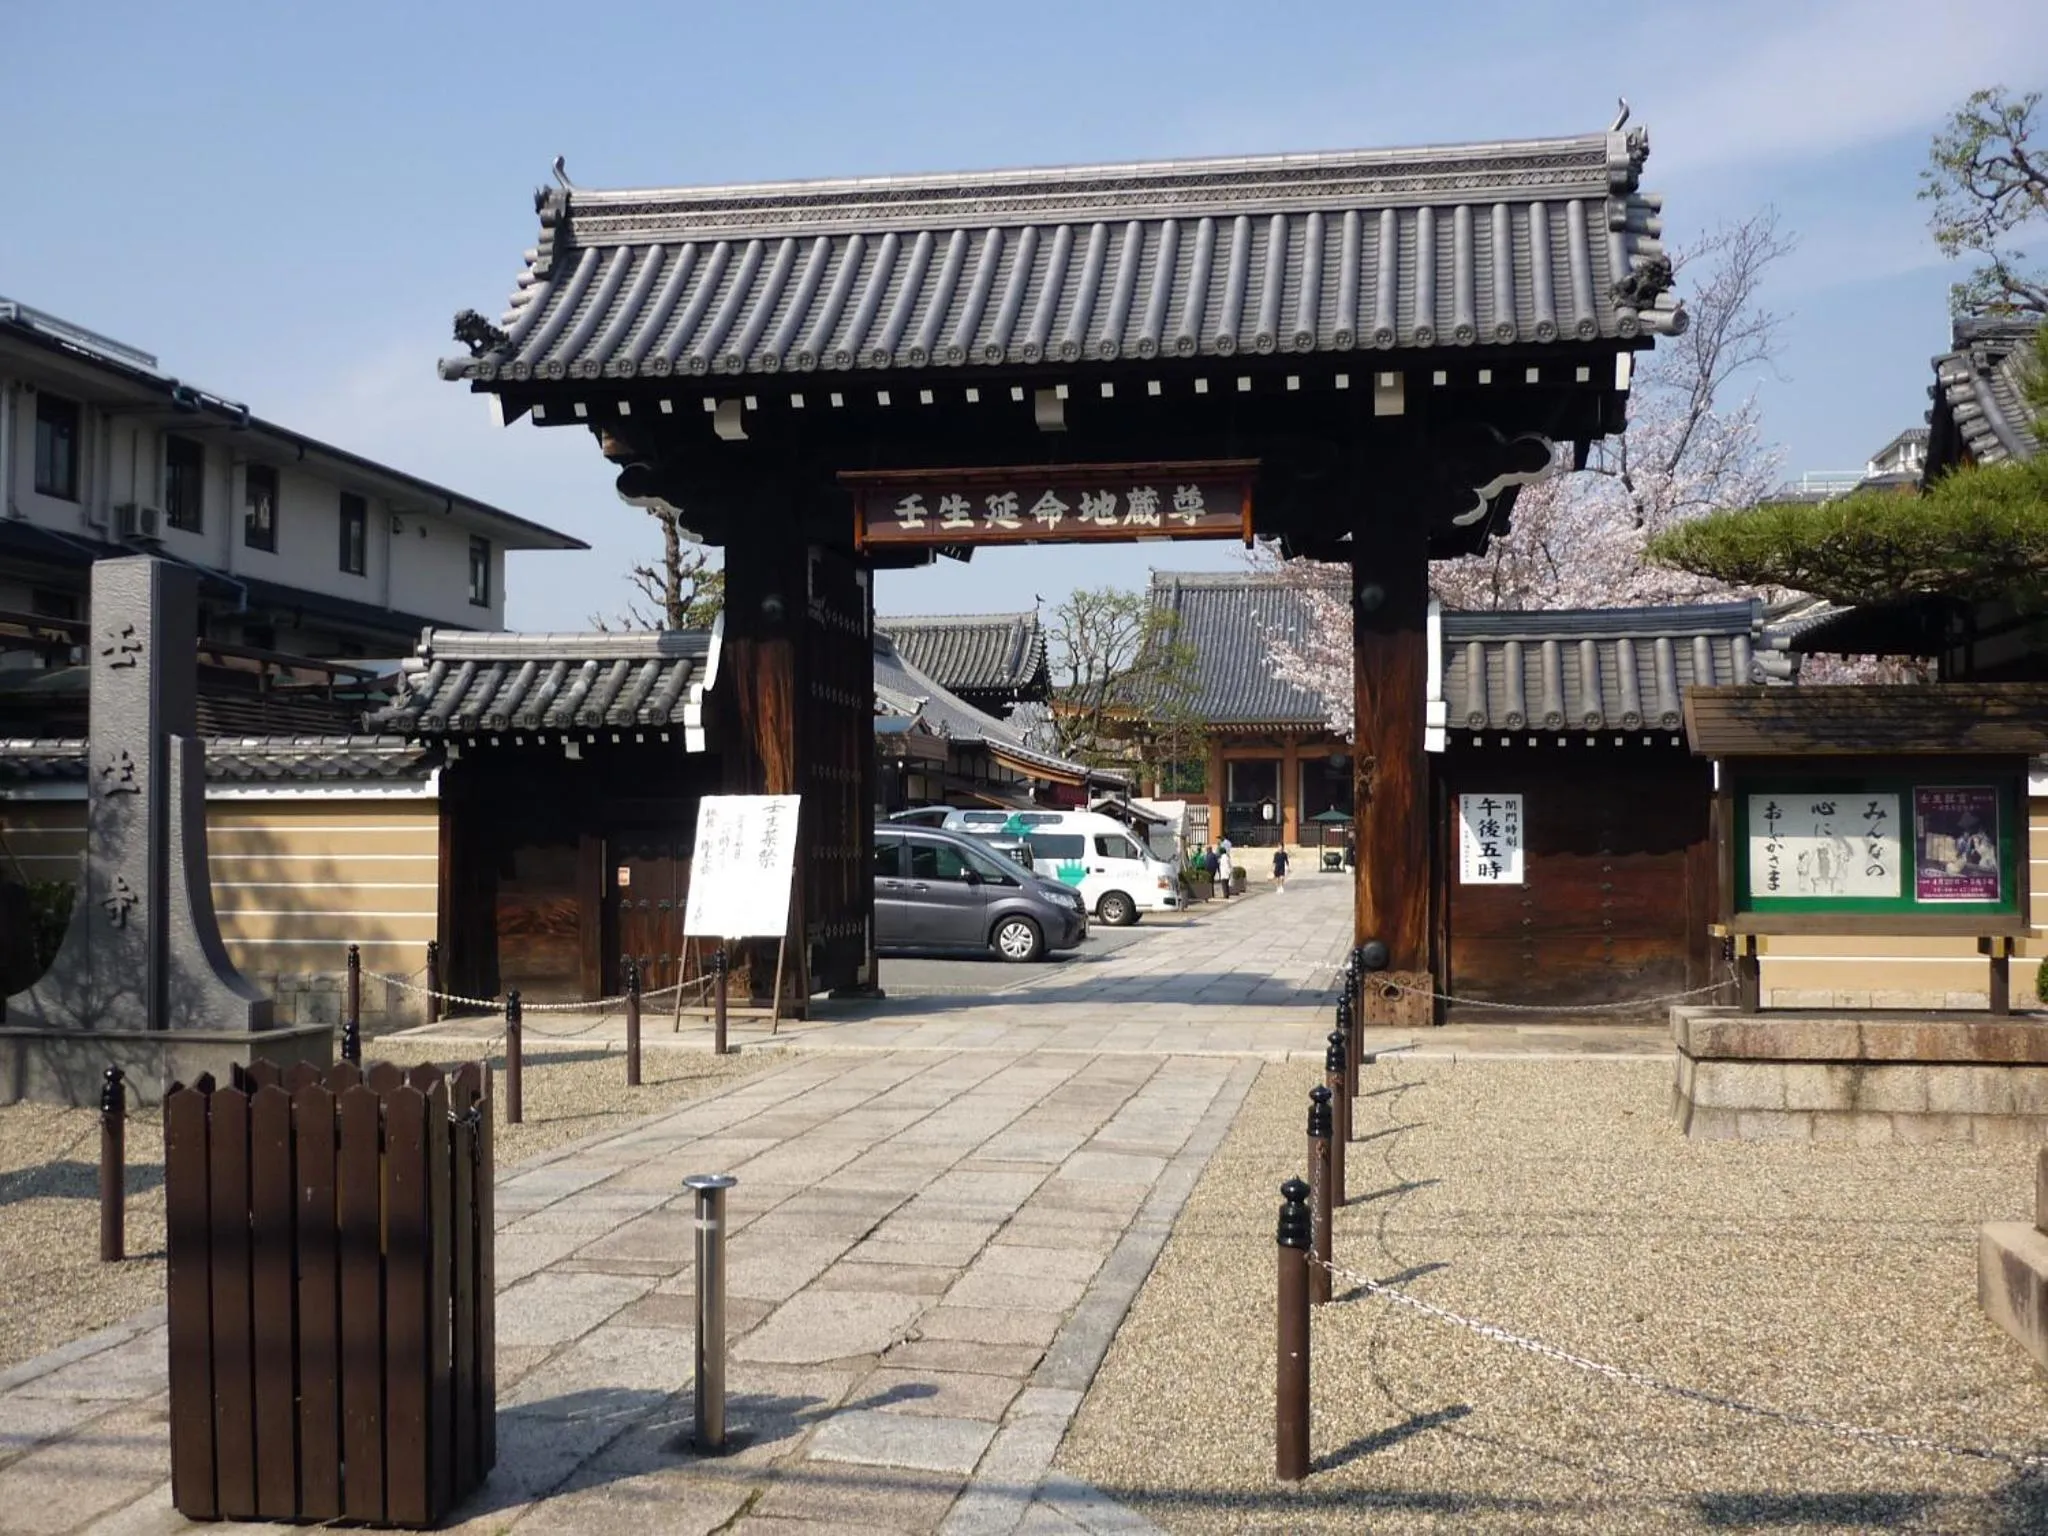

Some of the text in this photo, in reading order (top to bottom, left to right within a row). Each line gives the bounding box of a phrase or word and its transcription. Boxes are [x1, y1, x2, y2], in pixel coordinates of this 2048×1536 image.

[102, 623, 143, 929] 壬生寺
[1477, 797, 1502, 880] 午後五時
[1811, 801, 1838, 836] 心に
[1863, 801, 1888, 877] みんなの
